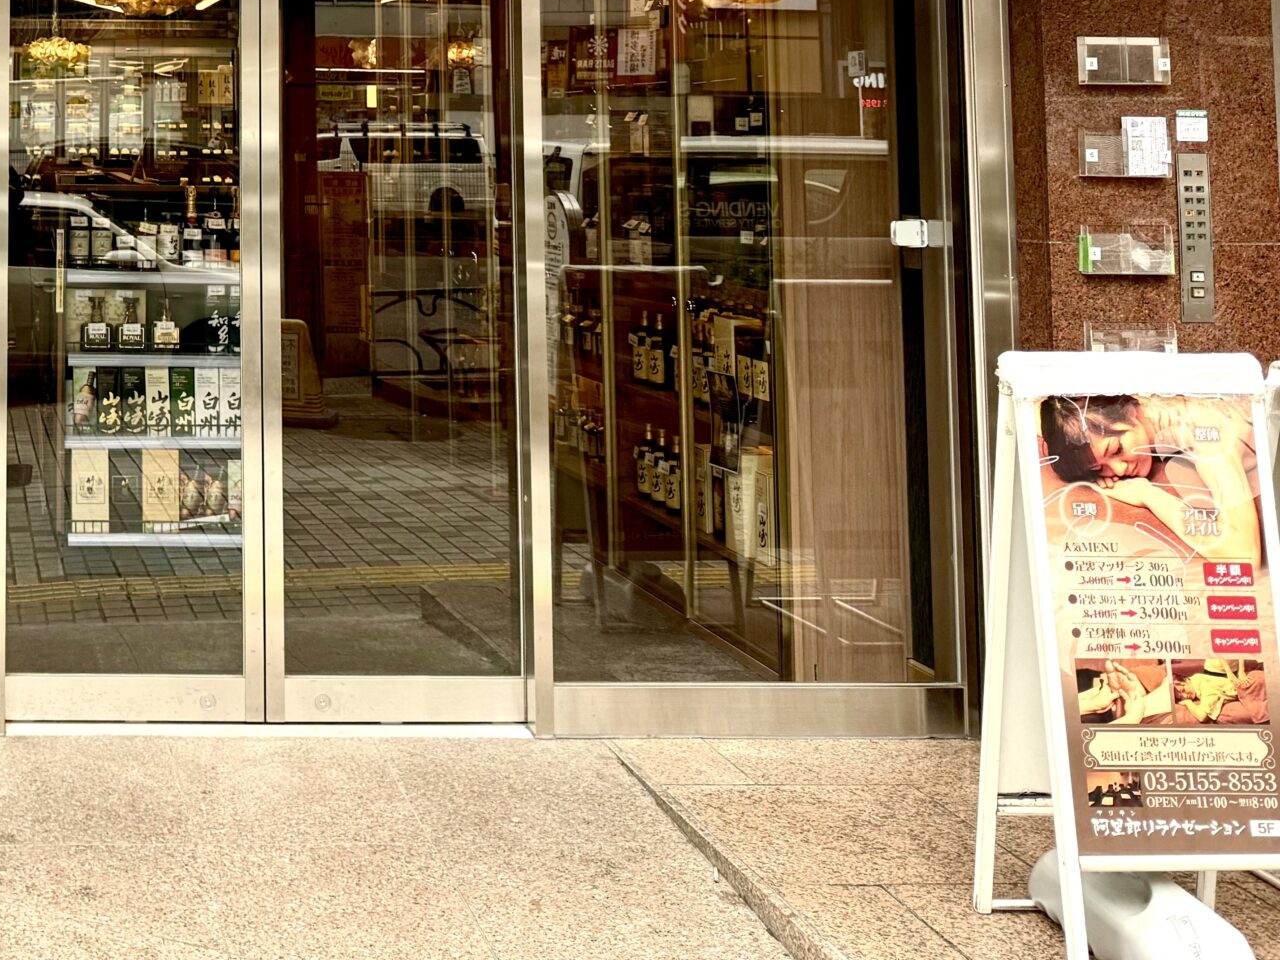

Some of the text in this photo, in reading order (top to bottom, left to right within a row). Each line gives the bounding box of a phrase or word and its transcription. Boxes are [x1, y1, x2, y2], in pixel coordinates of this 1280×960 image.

[99, 391, 122, 434] 山崎
[123, 390, 147, 434] 山崎
[148, 390, 171, 433] 山崎
[175, 391, 196, 435] 白州
[200, 391, 221, 436] 白州
[1183, 507, 1220, 522] アロマ
[1184, 522, 1220, 537] オイル
[1144, 771, 1277, 792] 03-5155-8553
[1258, 823, 1275, 834] 5F
